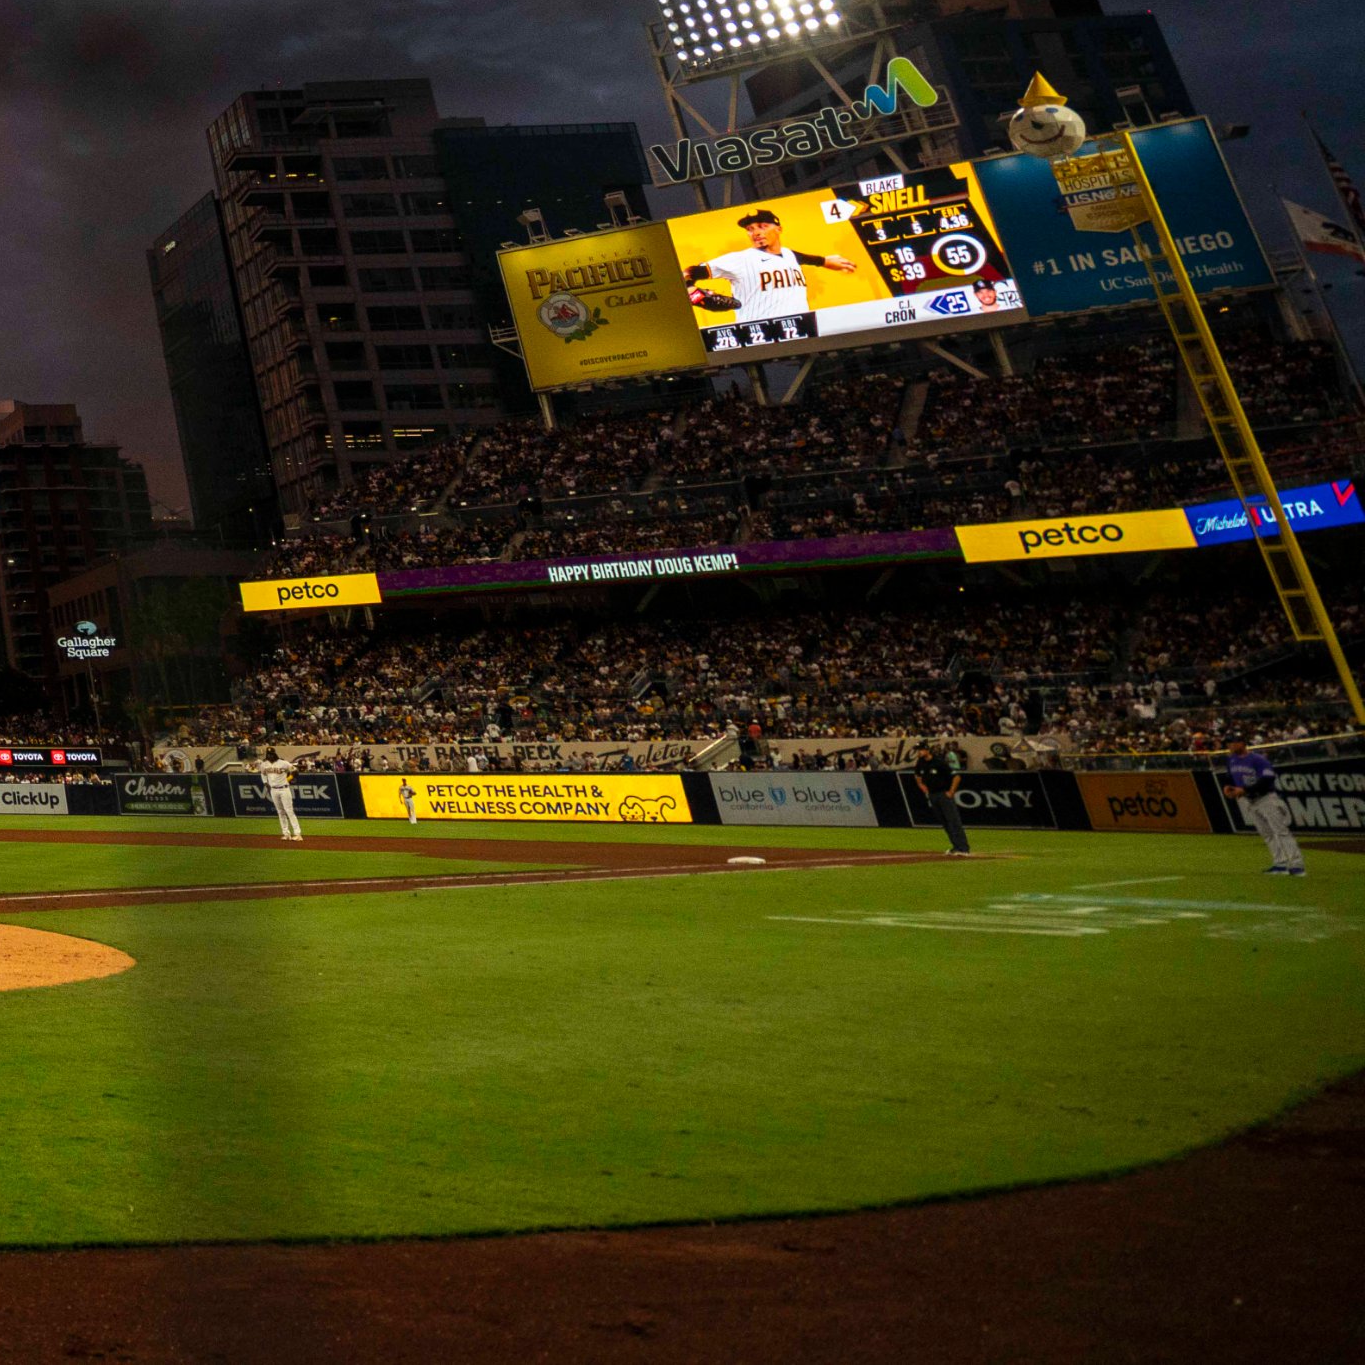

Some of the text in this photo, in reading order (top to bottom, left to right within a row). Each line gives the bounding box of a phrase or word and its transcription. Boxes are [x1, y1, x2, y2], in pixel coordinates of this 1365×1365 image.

[651, 106, 859, 183] Viasat
[865, 178, 899, 194] BLAKE
[869, 185, 930, 214] SNELL
[940, 214, 969, 230] 4.36
[895, 247, 916, 264] 16
[945, 245, 971, 265] 55
[1032, 244, 1152, 275] #1 IN SAN
[525, 255, 653, 300] PACIFICO
[903, 262, 926, 281] 39
[1100, 279, 1122, 292] UC
[1195, 261, 1245, 278] Health
[604, 290, 659, 308] CLARA
[946, 294, 968, 313] 25
[885, 309, 916, 324] CRON
[716, 329, 732, 338] AVG
[785, 327, 799, 338] 72
[579, 350, 649, 366] #DISCOVERPACIFICO
[1196, 513, 1249, 535] Michelob
[1018, 522, 1124, 553] petco
[548, 553, 739, 584] HAPPY BIRTHDAY DOUG KEMP!
[277, 580, 339, 606] petco
[57, 636, 116, 649] Gallagher
[67, 647, 110, 660] Square
[12, 752, 44, 760] TOYOTA
[66, 752, 98, 760] TOYOTA
[396, 745, 429, 762] THE
[513, 744, 561, 761] DECK
[124, 778, 185, 796] Chosen
[427, 784, 603, 798] PETCO THE HEALTH &
[719, 787, 765, 803] blue
[792, 787, 841, 803] blue
[1, 790, 59, 809] ClickUp
[730, 803, 774, 812] california
[805, 804, 851, 812] california
[1108, 791, 1178, 822] petco
[429, 801, 610, 816] WELLNESS COMPANY
